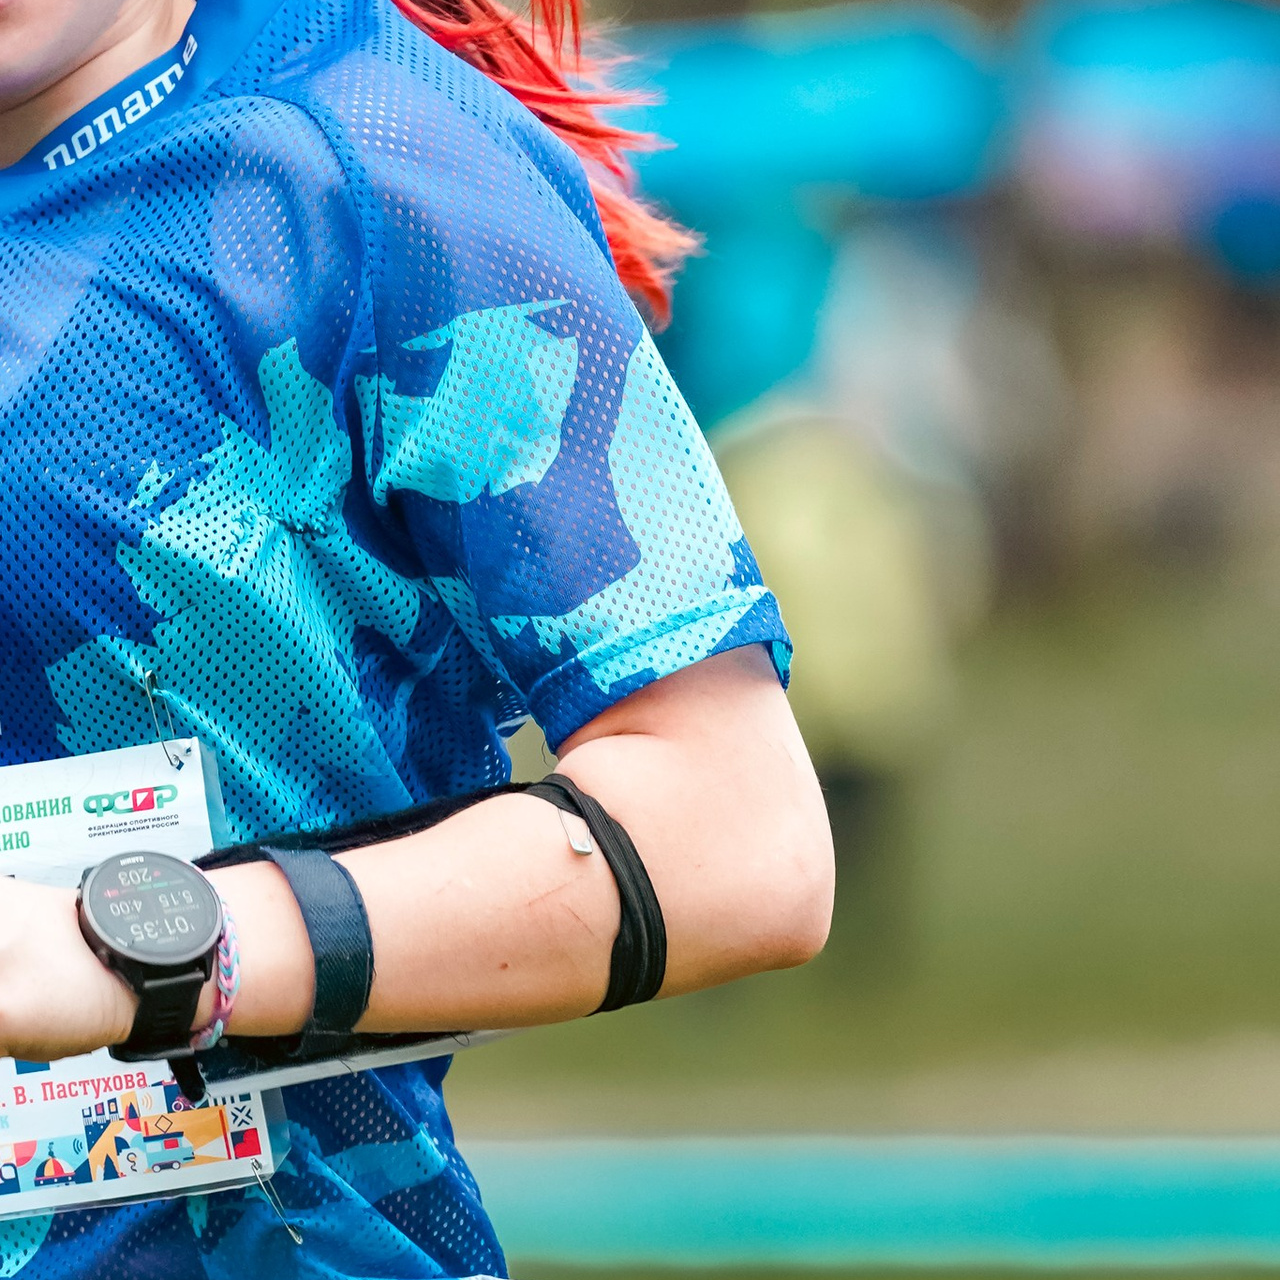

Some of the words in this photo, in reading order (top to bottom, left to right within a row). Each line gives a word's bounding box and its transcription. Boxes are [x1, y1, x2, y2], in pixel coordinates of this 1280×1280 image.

[129, 814, 179, 825] СПОРТИВНОГО
[151, 820, 180, 829] РОССИИ
[14, 1086, 34, 1105] В.
[41, 1071, 148, 1101] Пастухова
